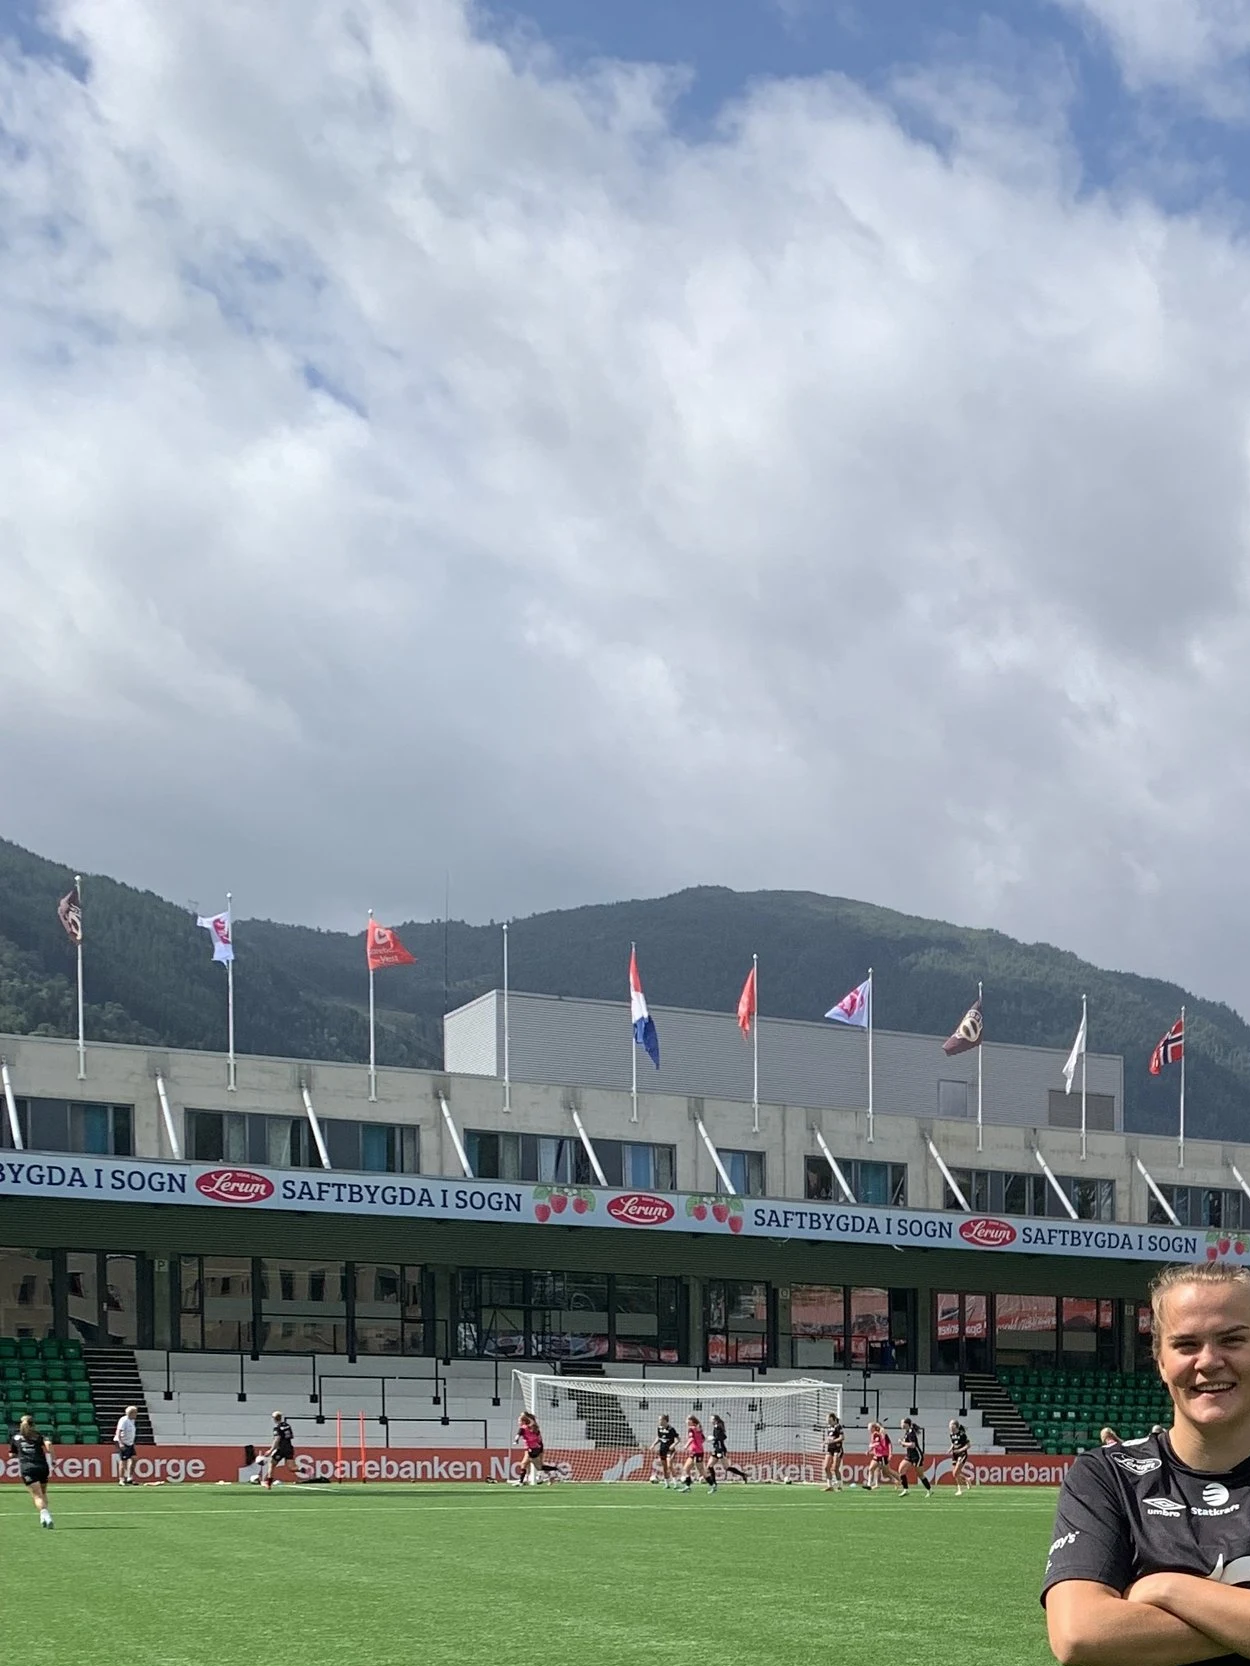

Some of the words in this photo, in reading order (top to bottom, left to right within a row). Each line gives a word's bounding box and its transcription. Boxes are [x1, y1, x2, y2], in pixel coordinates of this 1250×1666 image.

[94, 1168, 103, 1188] I
[110, 1169, 187, 1193] SOGN
[200, 1172, 267, 1200] Lerum
[282, 1180, 434, 1208] SAFTBYGDA
[441, 1191, 449, 1209] I
[455, 1190, 522, 1212] SOGN
[611, 1196, 668, 1223] Lerum
[754, 1208, 880, 1235] SAFTBYGDA
[886, 1217, 893, 1235] I
[897, 1219, 953, 1239] SOGN
[962, 1220, 1012, 1245] Lerum
[1022, 1226, 1133, 1250] SAFTBYGDA
[1137, 1234, 1144, 1251] I
[1148, 1234, 1198, 1254] SOGN
[295, 1455, 481, 1483] Sparebanken
[1147, 1509, 1181, 1518] umbro
